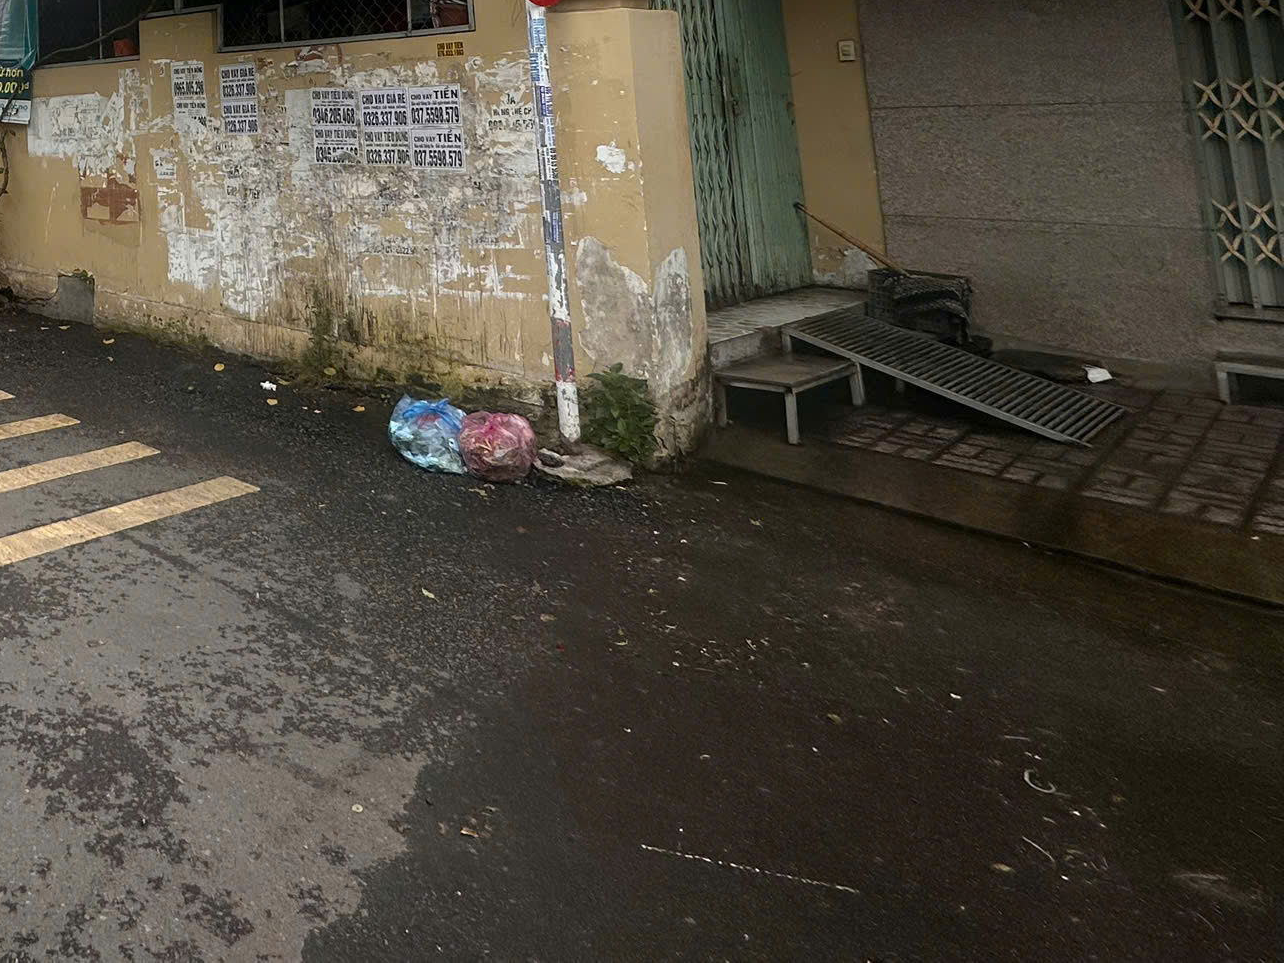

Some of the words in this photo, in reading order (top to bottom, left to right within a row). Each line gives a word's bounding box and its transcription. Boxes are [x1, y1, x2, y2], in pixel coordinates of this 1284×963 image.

[222, 70, 230, 79] CHO
[231, 69, 239, 78] VAY
[312, 91, 321, 99] CHO
[322, 91, 330, 99] VAY
[362, 95, 374, 105] CHO
[375, 94, 385, 105] VAY
[364, 111, 406, 126] 0326.337.906
[411, 107, 459, 124] 037.5598.579
[315, 130, 324, 138] CHO
[325, 130, 333, 138] VAY
[365, 131, 374, 141] CHO
[374, 131, 382, 141] VAY
[366, 149, 410, 164] 0326.337.906
[414, 150, 462, 166] 037.5598.579
